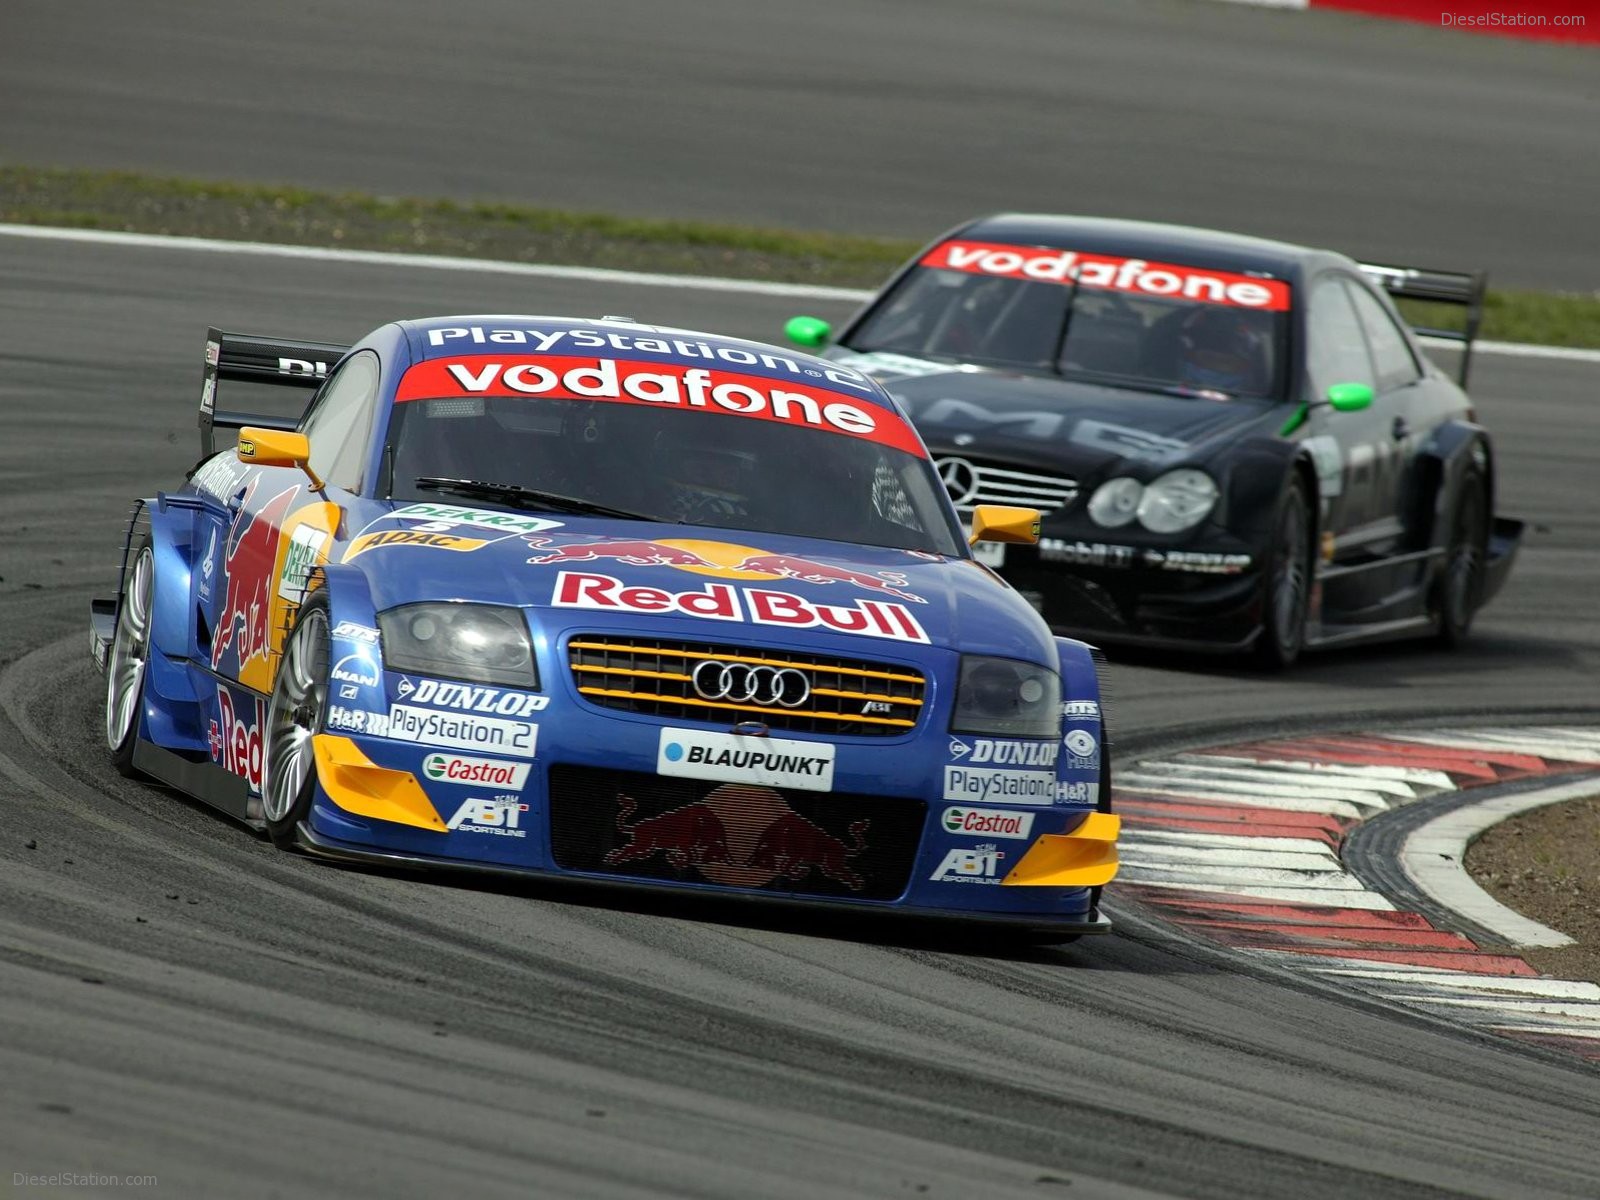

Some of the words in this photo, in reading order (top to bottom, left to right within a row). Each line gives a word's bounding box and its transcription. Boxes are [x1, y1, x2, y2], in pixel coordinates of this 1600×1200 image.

[946, 246, 1273, 307] vodafone
[427, 327, 800, 374] PlayStation
[446, 360, 877, 434] vodafone
[402, 505, 541, 531] DEKRA
[410, 520, 461, 532] 5
[359, 531, 461, 550] ADAC
[558, 572, 735, 618] Red
[747, 589, 923, 640] Bull
[333, 669, 377, 688] MAN
[410, 679, 551, 718] DUNLOP
[861, 701, 894, 714] ABT
[328, 704, 367, 733] H&R
[392, 708, 504, 745] PlayStation
[512, 723, 532, 749] 2
[218, 685, 265, 790] Red
[687, 745, 829, 777] BLAUPUNKT
[969, 739, 1060, 766] DUNLOP
[447, 759, 516, 785] Castrol
[949, 770, 1043, 801] PlayStation
[1056, 781, 1087, 804] H&R
[446, 797, 528, 830] ABT
[964, 811, 1023, 834] Castrol
[459, 823, 527, 838] SPORTSLINE
[929, 848, 1004, 881] ABT
[943, 874, 1003, 886] SPORTSLINE
